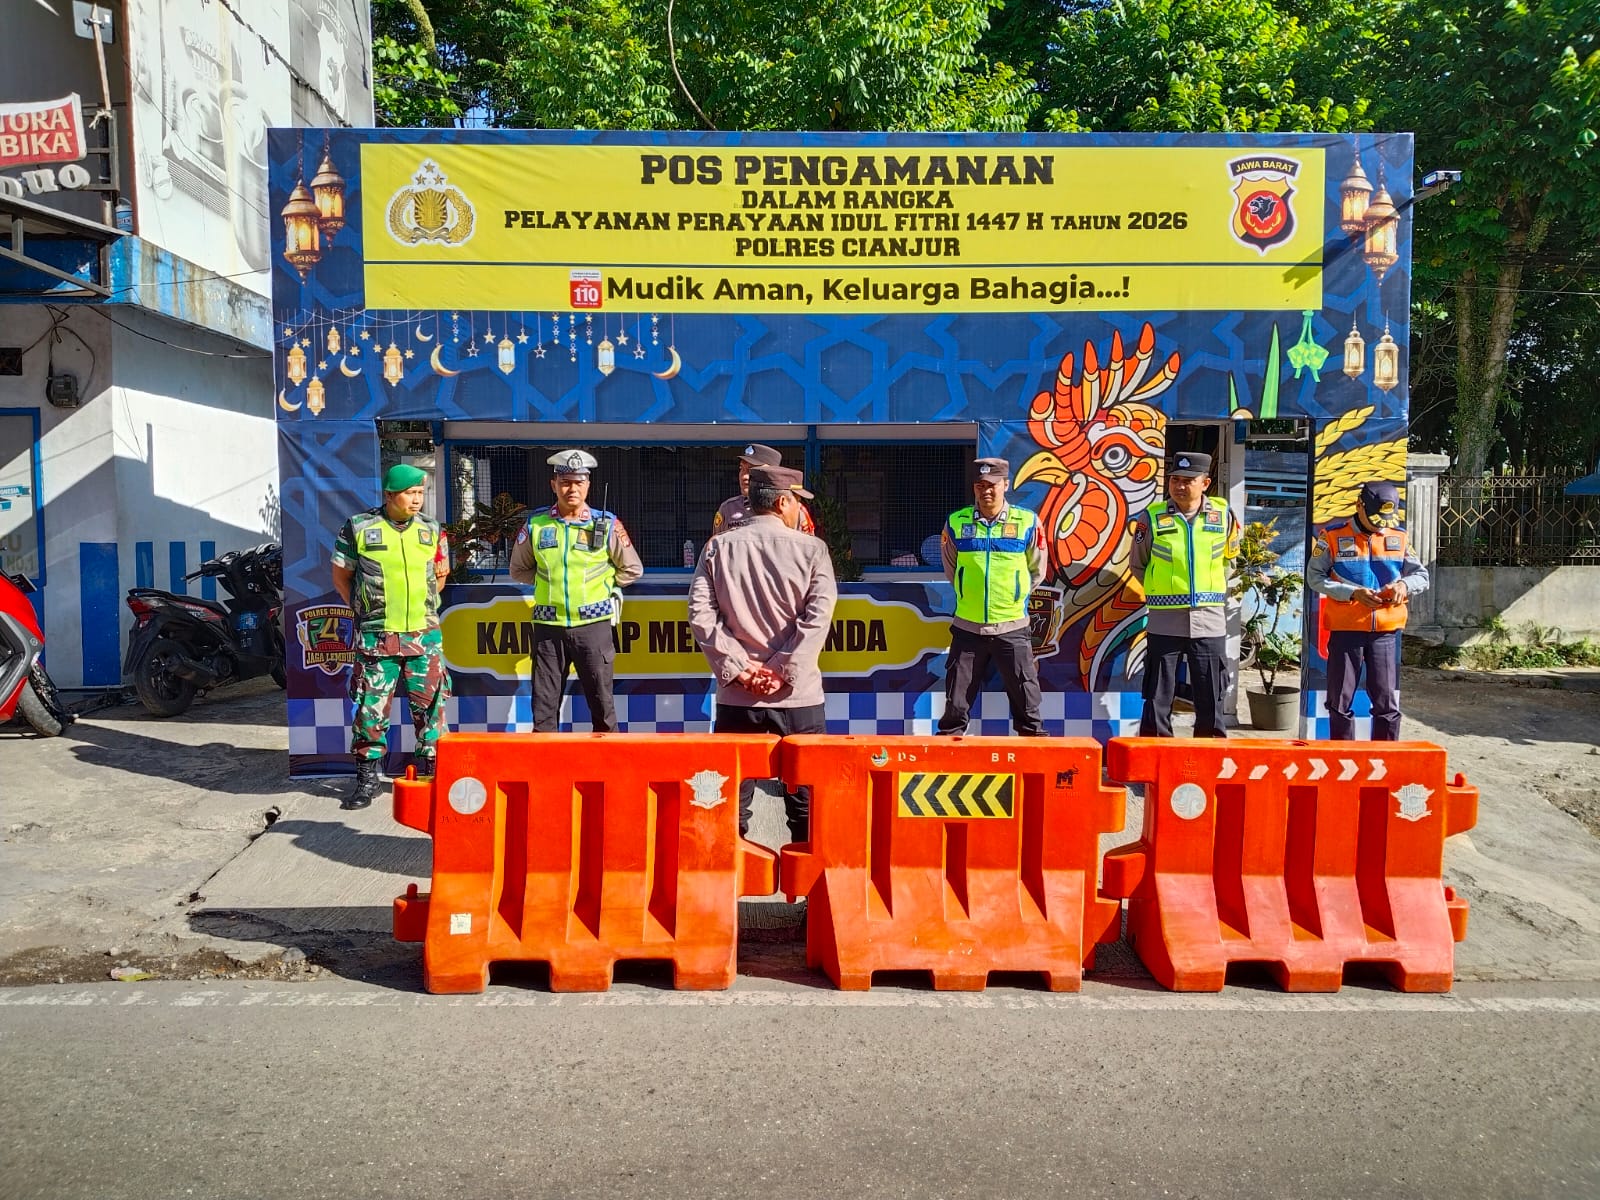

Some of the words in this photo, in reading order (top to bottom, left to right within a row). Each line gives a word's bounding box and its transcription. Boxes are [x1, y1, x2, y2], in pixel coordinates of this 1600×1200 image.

[0, 132, 72, 157] BIKA
[641, 155, 722, 185] POS
[735, 156, 1054, 185] PENGAMANAN
[1236, 161, 1261, 173] JAWA
[1263, 161, 1294, 173] BARAT
[742, 191, 836, 208] DALAM
[844, 191, 954, 208] RANGKA
[505, 211, 670, 230] PELAYANAN
[678, 213, 824, 231] PERAYAAN
[831, 213, 888, 231] IDUL
[894, 213, 960, 231] FITRI
[967, 213, 1020, 231] 1447
[1027, 213, 1044, 230] H
[1051, 216, 1121, 230] TAHUN
[1128, 212, 1188, 230] 2026
[736, 238, 834, 257] POLRES
[843, 238, 960, 256] CIANJUR
[574, 287, 599, 302] 110
[608, 275, 704, 300] Mudik
[714, 279, 813, 305] Aman,
[824, 277, 960, 306] Keluarga
[971, 274, 1130, 305] Bahagia...!
[307, 652, 325, 665] JAGA
